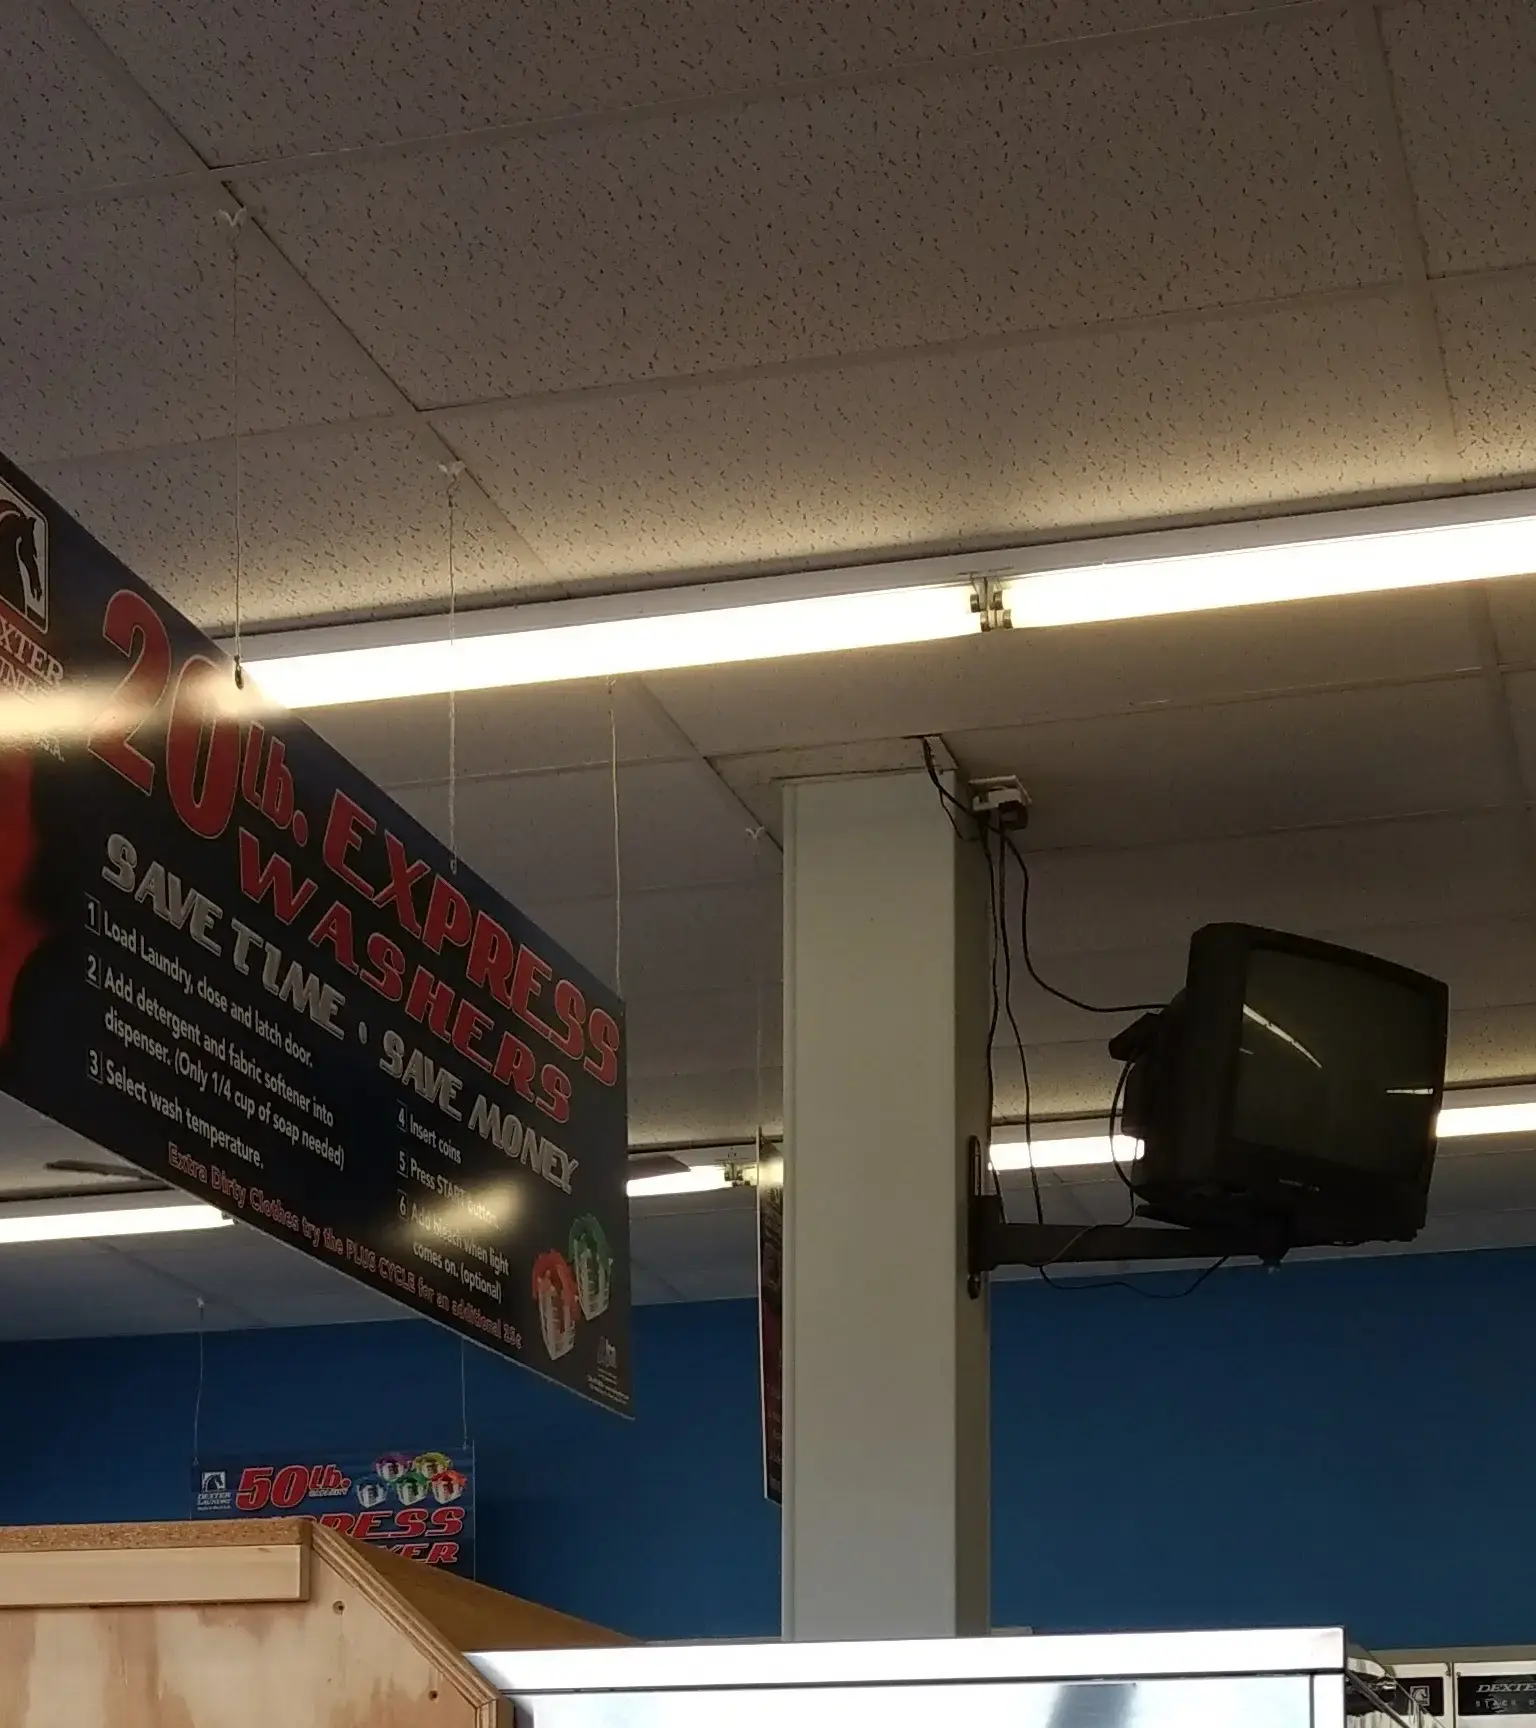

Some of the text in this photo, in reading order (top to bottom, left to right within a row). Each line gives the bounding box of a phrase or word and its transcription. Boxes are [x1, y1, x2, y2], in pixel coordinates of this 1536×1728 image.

[101, 833, 580, 1196] SAVE TIME SAVE MONEY
[104, 911, 138, 950] Load
[141, 935, 194, 995] Laundry,
[197, 976, 228, 1013] close
[230, 999, 253, 1029] and
[254, 1010, 283, 1049] latch
[285, 1032, 314, 1068] door.
[239, 826, 572, 1124] WASHERS
[322, 788, 620, 1086] EXPRESS
[104, 966, 134, 1005] Add
[136, 986, 202, 1047] detergent
[203, 1037, 226, 1062] and
[228, 1042, 263, 1084] fabric
[264, 1072, 312, 1114] softener
[313, 1096, 334, 1128] into
[104, 1006, 345, 1171] dispenser. (Only 1/4 cup of soap needed)
[104, 1059, 148, 1106] Select
[150, 1089, 184, 1124] wash
[185, 1107, 265, 1170] temperature.
[410, 1113, 437, 1148] Insert
[438, 1136, 462, 1164] coins
[410, 1158, 436, 1190] Press
[437, 1174, 468, 1206] START
[168, 1141, 208, 1184] Extra
[211, 1165, 246, 1209] Dirty
[249, 1187, 300, 1232] Clothes
[301, 1216, 321, 1248] try
[323, 1227, 344, 1256] the
[346, 1237, 376, 1273] PLUS
[378, 1256, 416, 1294] CYCLE
[418, 1276, 435, 1302] for
[436, 1292, 450, 1312] an
[451, 1299, 502, 1339] additional
[411, 1202, 432, 1231] Add
[463, 1235, 488, 1264] when
[489, 1245, 510, 1276] light
[413, 1241, 503, 1305] comes on. (optional)
